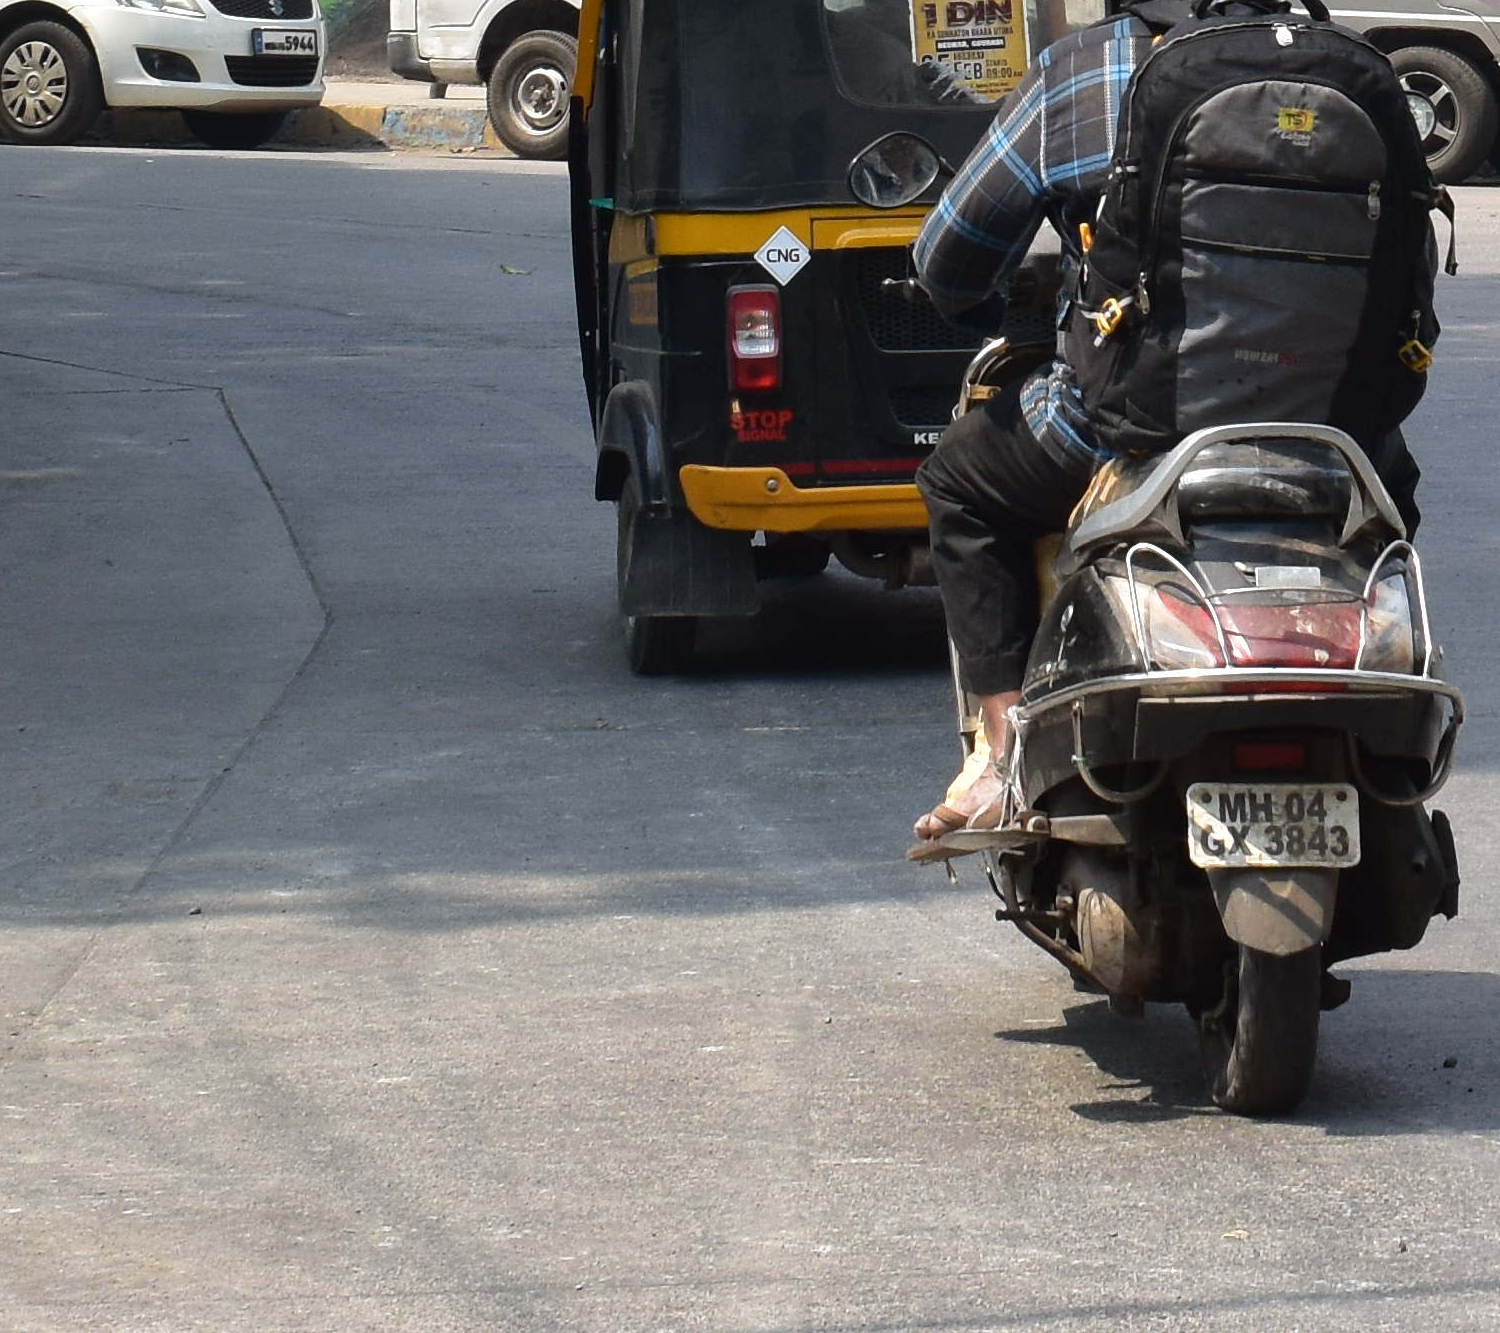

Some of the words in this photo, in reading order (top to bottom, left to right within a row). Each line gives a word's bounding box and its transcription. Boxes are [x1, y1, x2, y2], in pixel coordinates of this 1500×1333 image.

[766, 248, 800, 263] CNG
[731, 409, 794, 430] STOP
[737, 429, 786, 443] SIGNAL
[914, 433, 943, 445] KE
[1219, 793, 1272, 823] MH
[1286, 792, 1326, 822] 04
[1201, 826, 1249, 856] GX
[1265, 825, 1350, 857] 3843
